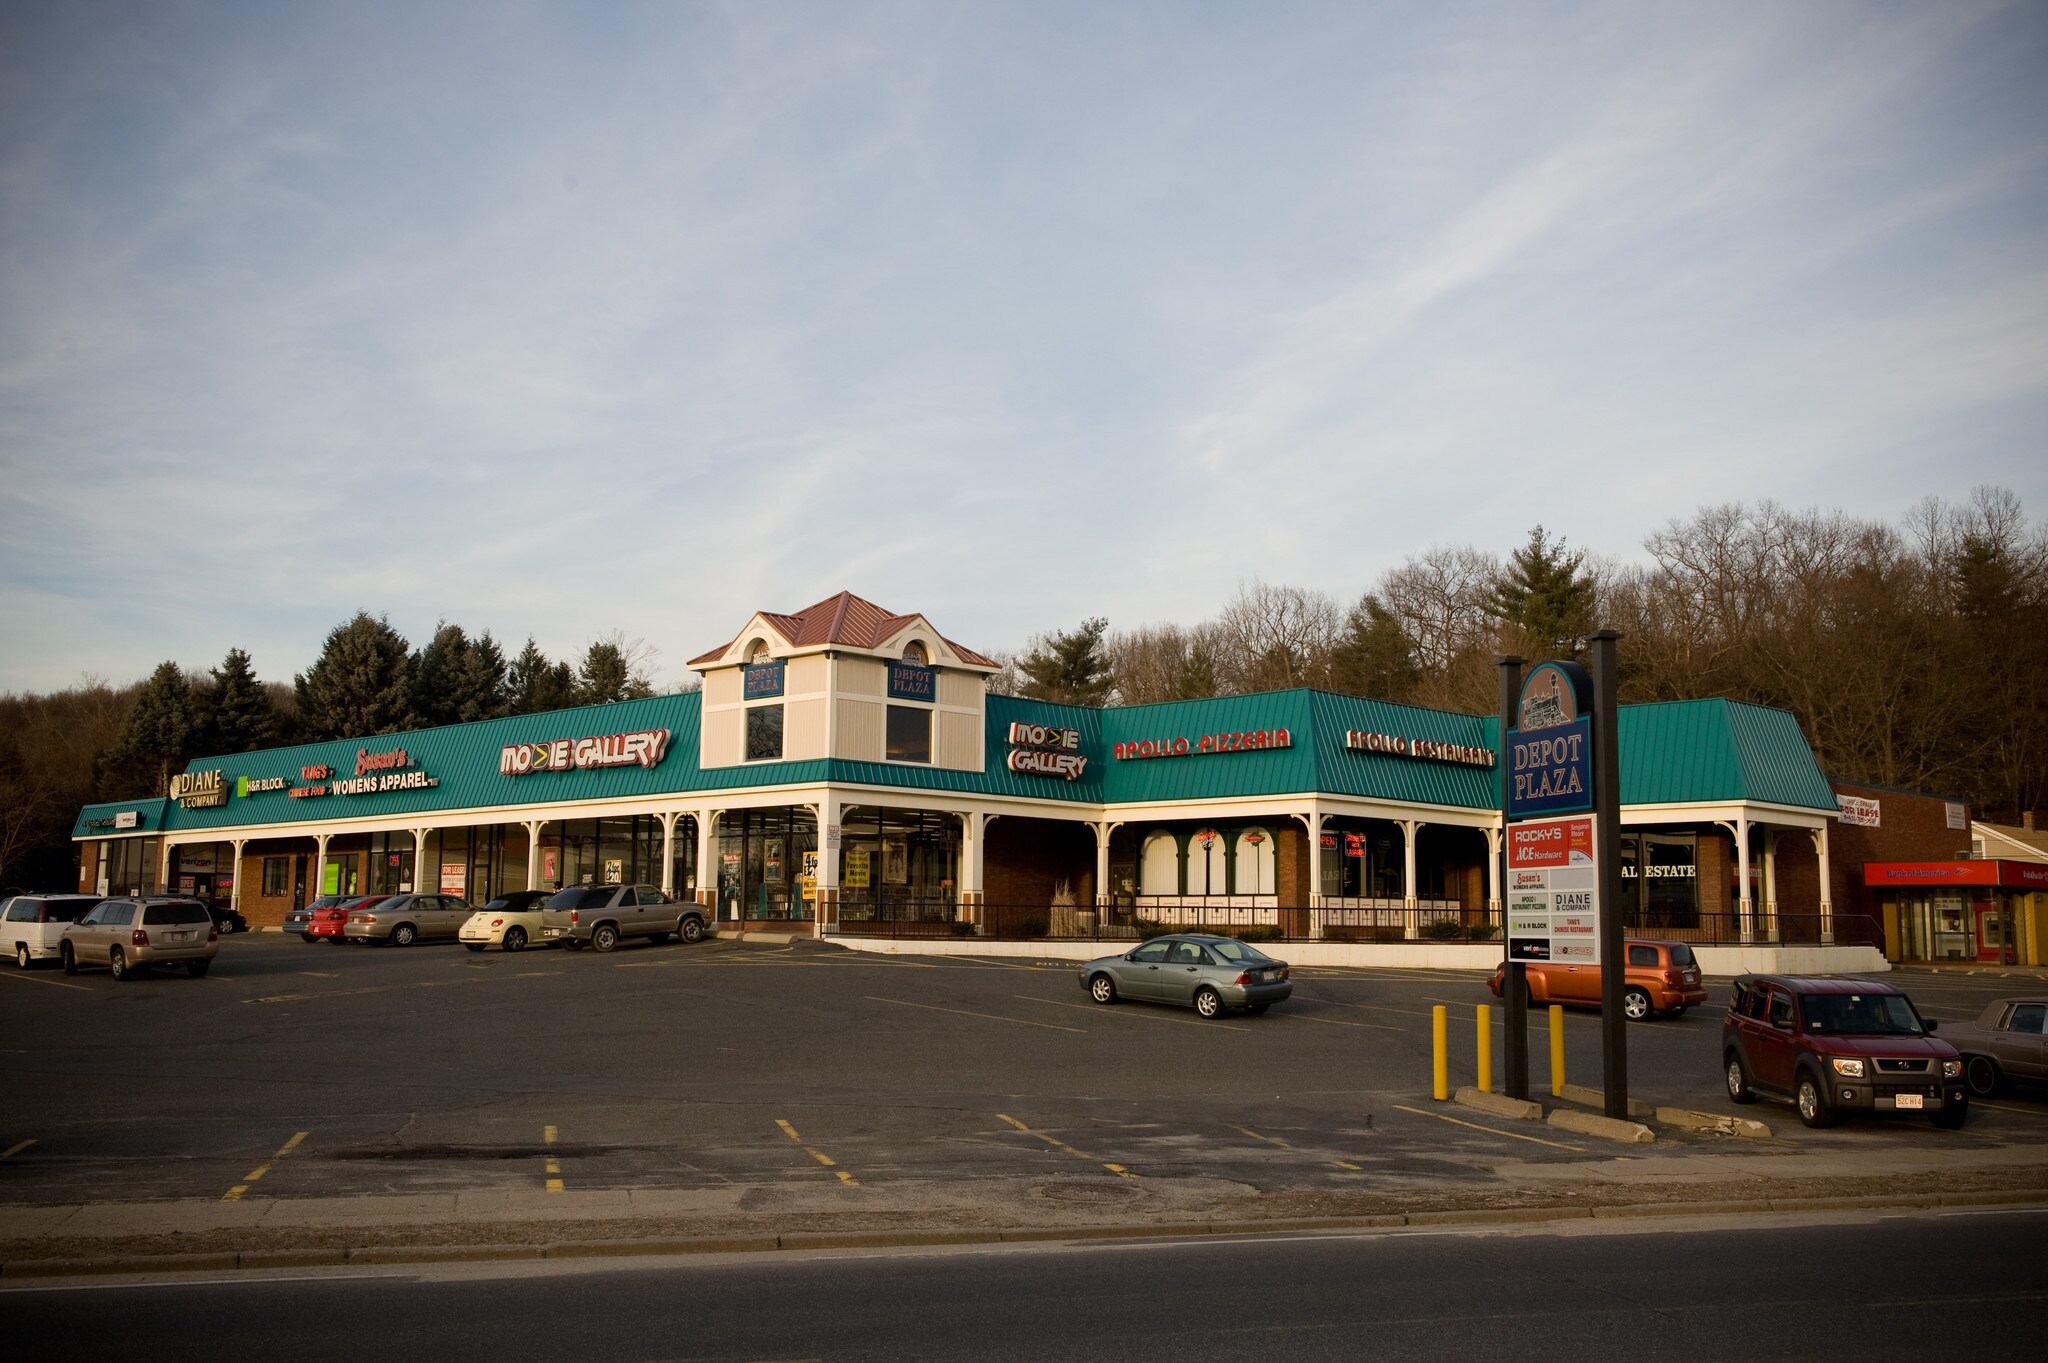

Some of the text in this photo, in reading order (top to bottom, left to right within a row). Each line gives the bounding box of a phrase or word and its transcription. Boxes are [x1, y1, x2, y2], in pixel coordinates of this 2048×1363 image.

[748, 666, 779, 681] DEPOT
[893, 668, 931, 683] DEPOT
[748, 679, 778, 693] PLAZA
[893, 680, 930, 694] PLAZA
[575, 729, 666, 769] GALLERY
[1113, 728, 1291, 760] APOLLO PIZZERIA
[1346, 729, 1495, 766] APOLLO RESTAURANT
[1514, 733, 1582, 771] DEPOT
[356, 748, 408, 776] Susan's
[1012, 751, 1088, 779] GALLERY
[181, 769, 221, 793] DIANE
[246, 777, 284, 792] H&R BLOCK
[332, 771, 429, 795] WOMENS APPAREL
[1514, 766, 1583, 801] PLAZA
[180, 795, 219, 808] & COMPANY
[1840, 805, 1879, 817] FOR LEASE
[1571, 823, 1590, 831] Benjamin
[1320, 835, 1335, 846] PEN
[1515, 827, 1562, 843] ROCKY'S
[805, 854, 811, 866] 4
[1516, 846, 1563, 861] ACE Hardware
[181, 858, 211, 868] verizon
[442, 866, 465, 875] FOR LEASE
[1517, 872, 1541, 885] Susan's
[1621, 865, 1696, 878] AL ESTATE
[1887, 869, 1907, 877] Bank
[1556, 894, 1591, 904] DIANE
